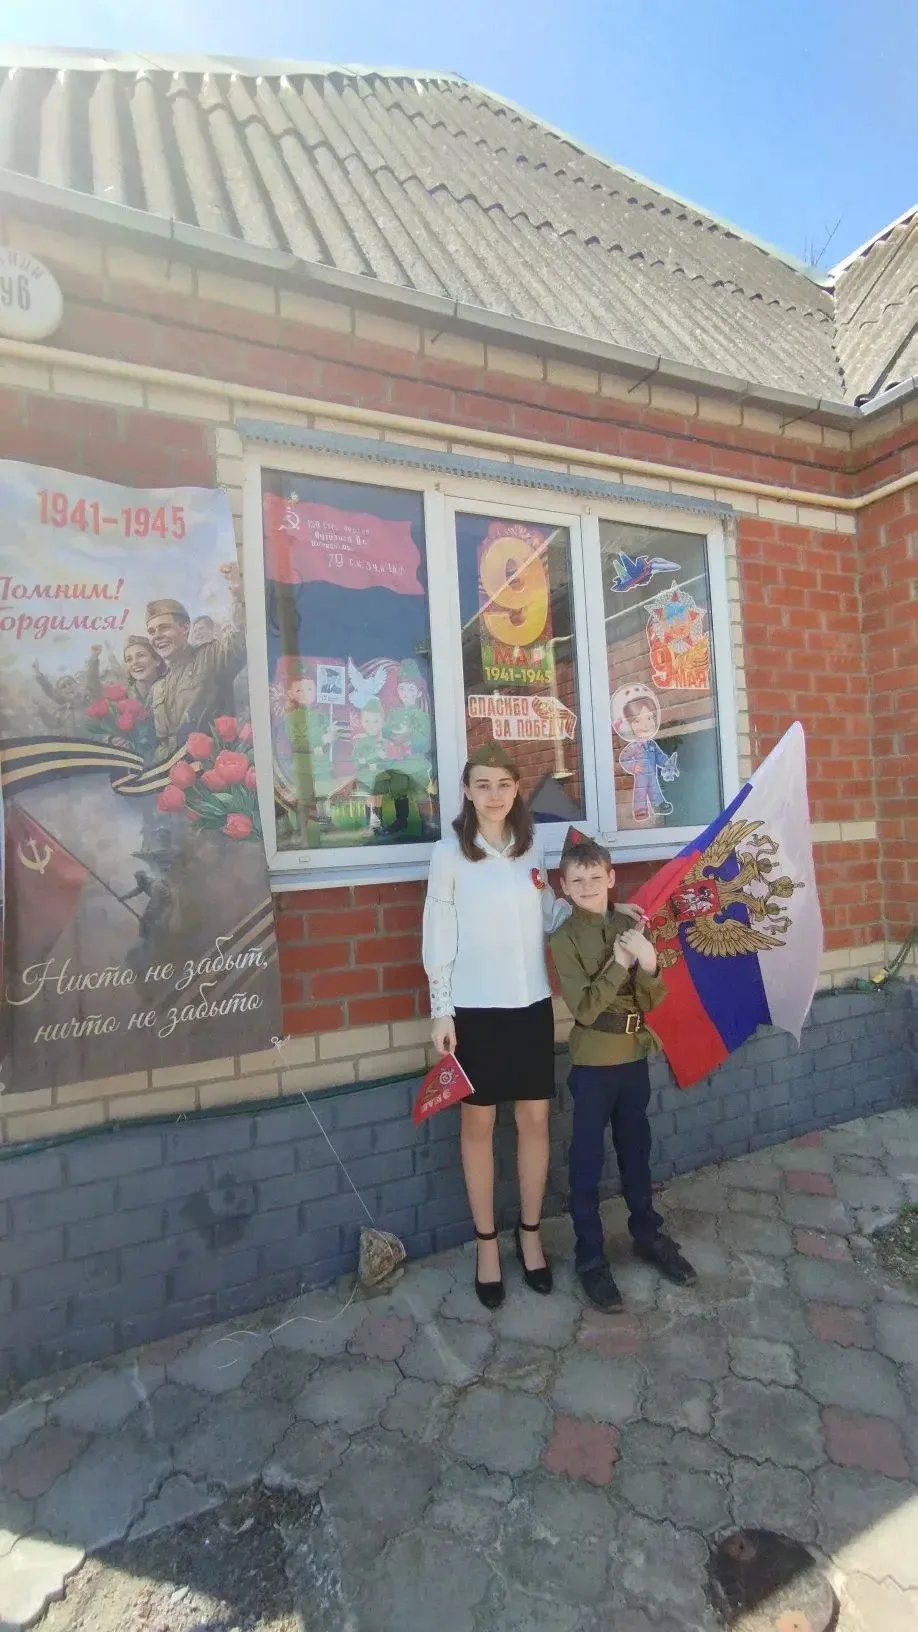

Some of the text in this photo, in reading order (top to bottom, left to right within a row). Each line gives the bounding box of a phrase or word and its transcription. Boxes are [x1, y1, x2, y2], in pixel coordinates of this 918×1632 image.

[37, 489, 187, 540] 1941-1945
[480, 536, 548, 646] 9
[485, 666, 552, 683] 1941-1945
[469, 696, 529, 717] СПАСИБО
[495, 719, 511, 738] ЗА
[5, 935, 269, 1006] Никто не забыт,
[33, 981, 264, 1043] ничто не забыто
